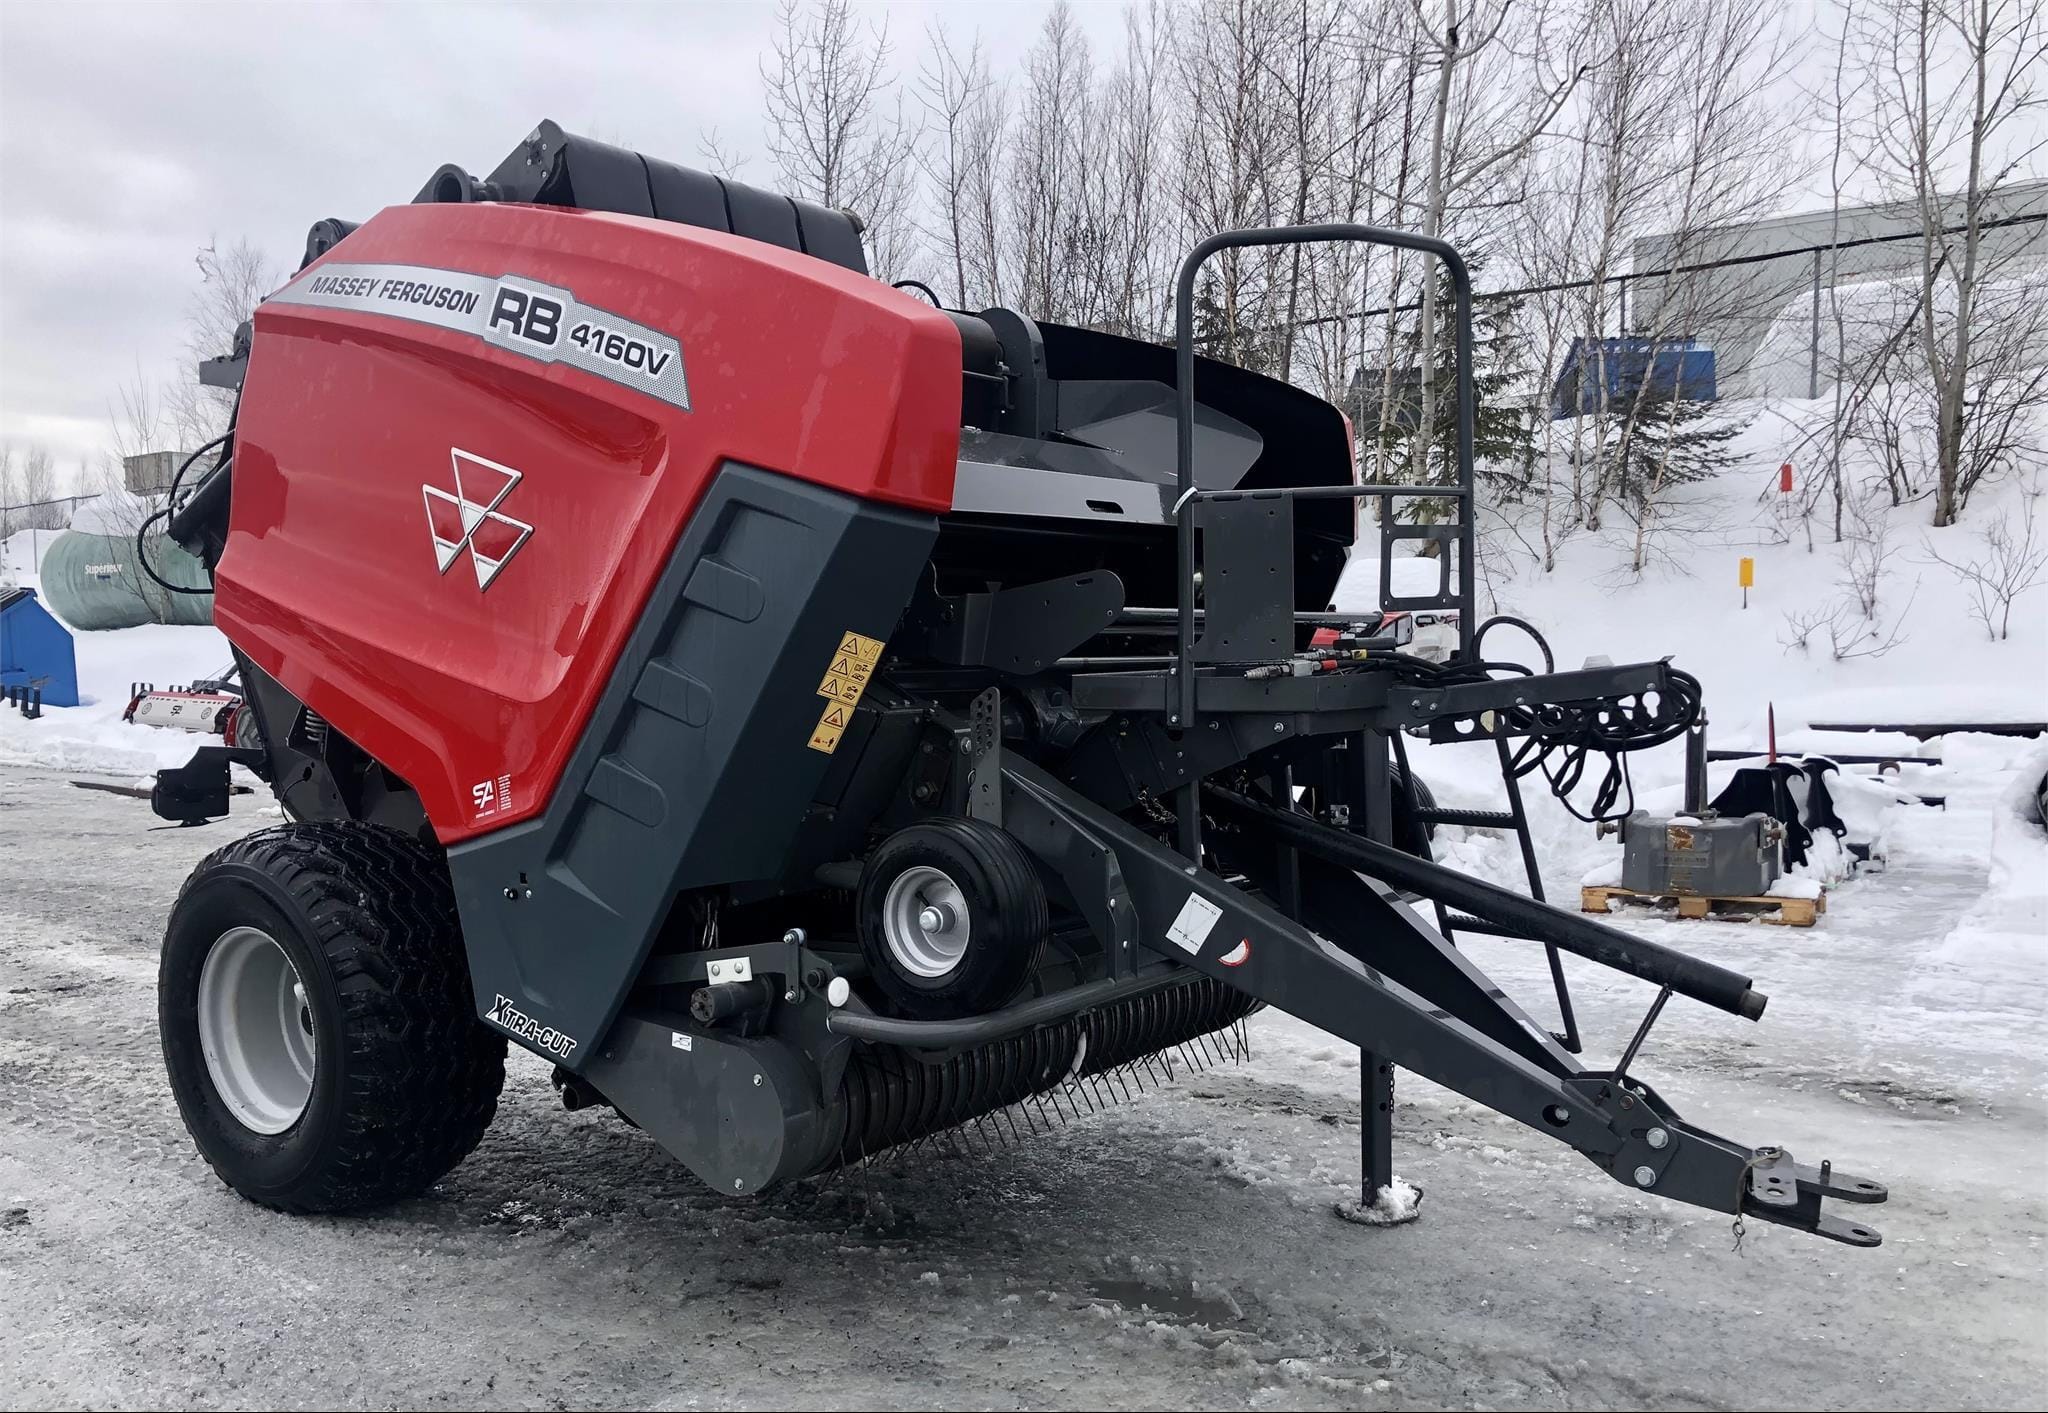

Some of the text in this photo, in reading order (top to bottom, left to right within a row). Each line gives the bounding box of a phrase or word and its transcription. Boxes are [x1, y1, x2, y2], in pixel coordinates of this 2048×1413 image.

[309, 276, 480, 315] MASSEY FERGUSON
[489, 286, 670, 375] RB 4160V
